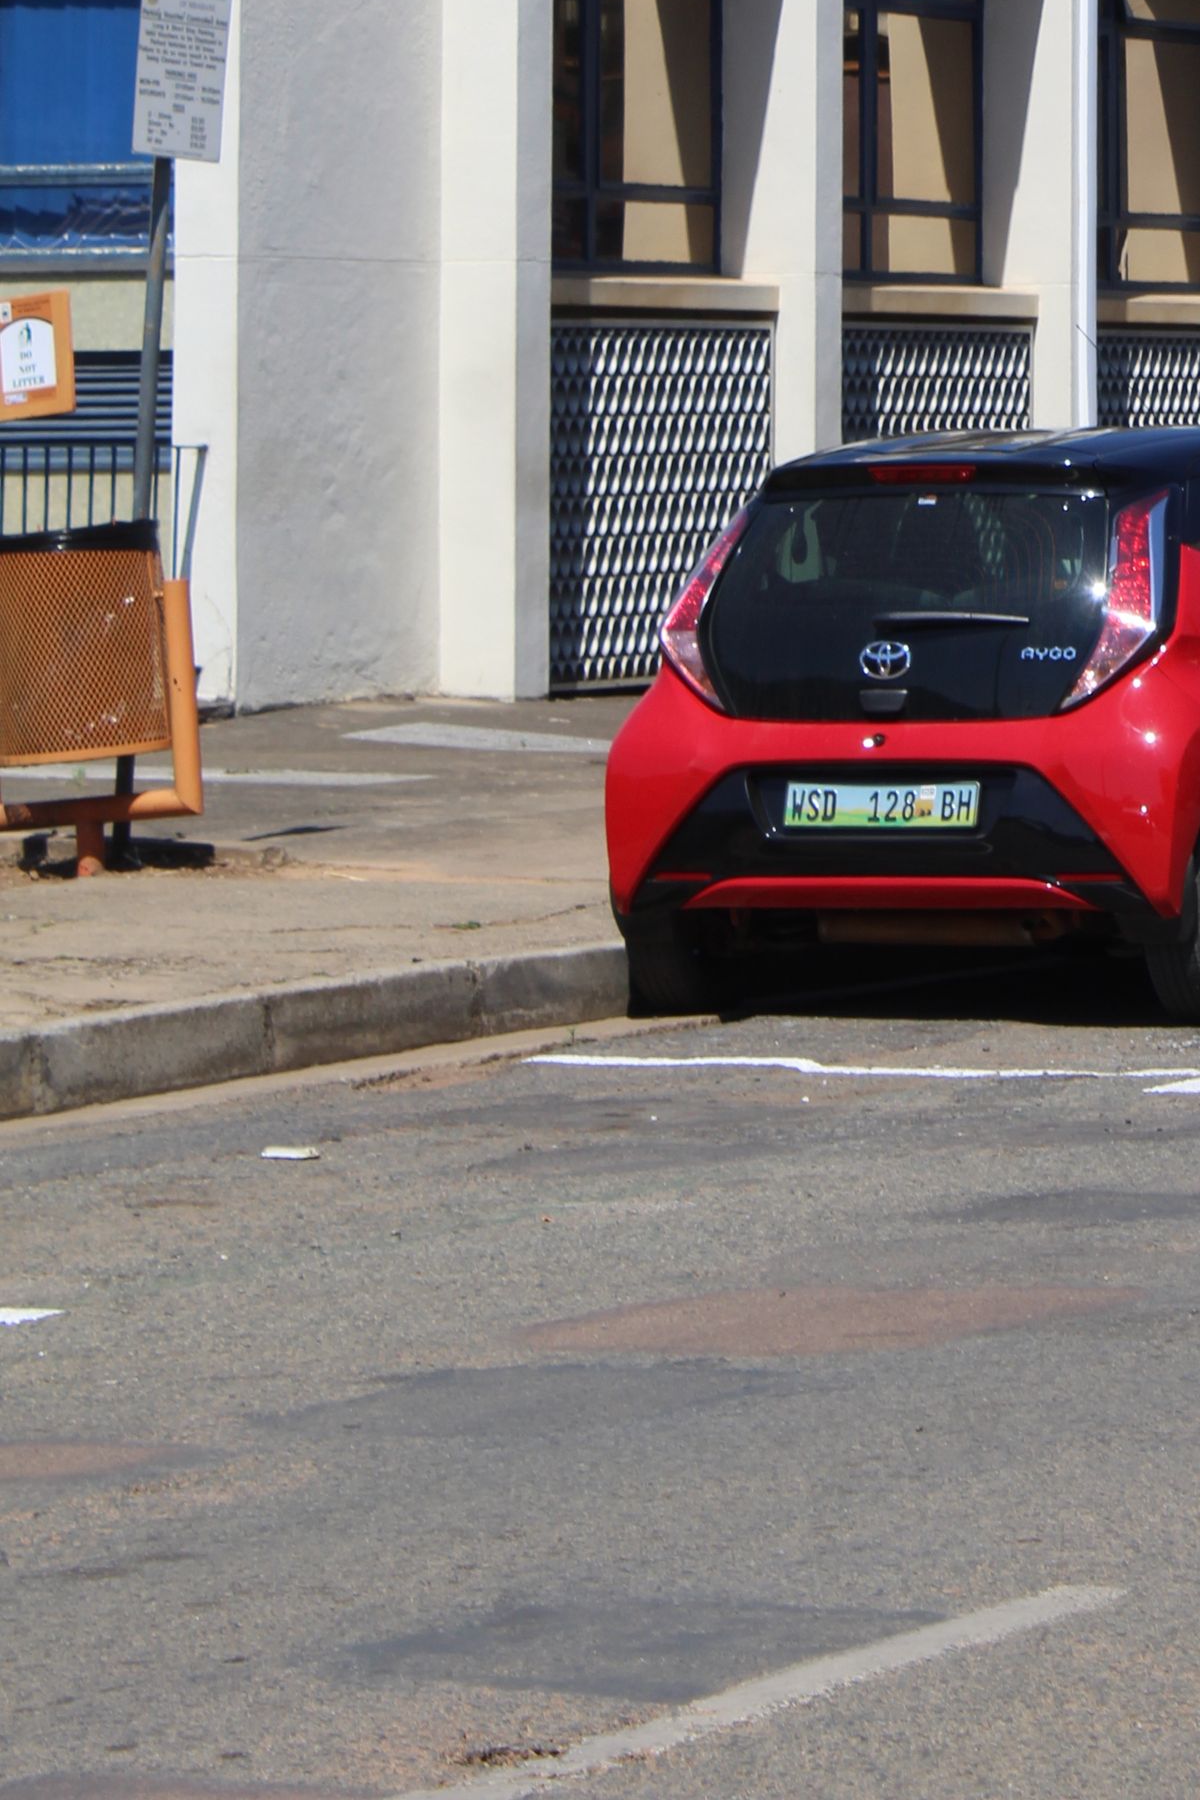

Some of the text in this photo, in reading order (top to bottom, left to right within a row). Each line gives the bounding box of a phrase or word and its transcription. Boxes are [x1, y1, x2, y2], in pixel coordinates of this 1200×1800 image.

[12, 375, 45, 389] LITTER
[1020, 646, 1076, 661] AYGO
[867, 789, 917, 822] 128
[940, 789, 972, 822] BH
